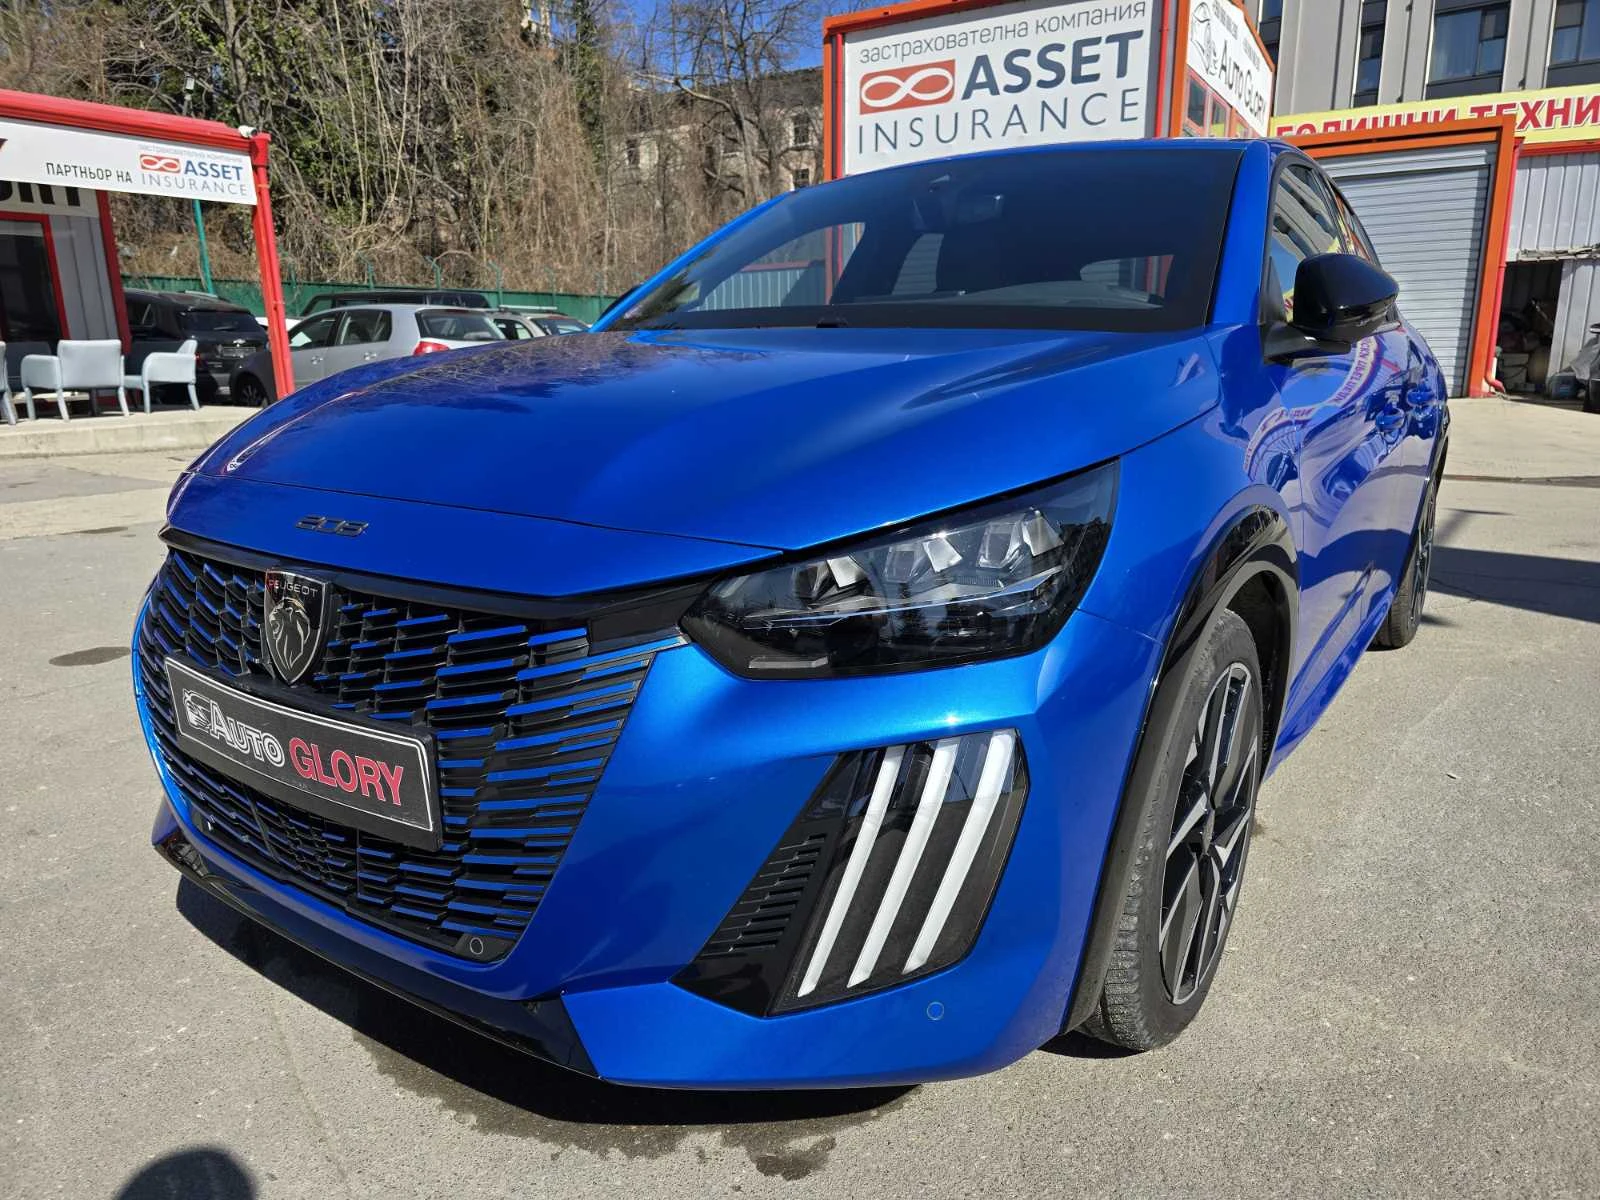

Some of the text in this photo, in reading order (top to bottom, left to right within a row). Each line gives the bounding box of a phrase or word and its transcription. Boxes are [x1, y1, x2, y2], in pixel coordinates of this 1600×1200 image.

[859, 1, 1146, 63] застрахователна компания
[961, 29, 1144, 100] ASSET
[858, 87, 1140, 154] INSURANCE
[46, 162, 133, 184] ПАРТНЬОР НА
[184, 160, 243, 181] ASSET
[142, 173, 247, 196] INSURANCE
[296, 514, 369, 537] 208
[268, 577, 319, 598] PEUGEOT
[288, 736, 404, 807] GLORY
